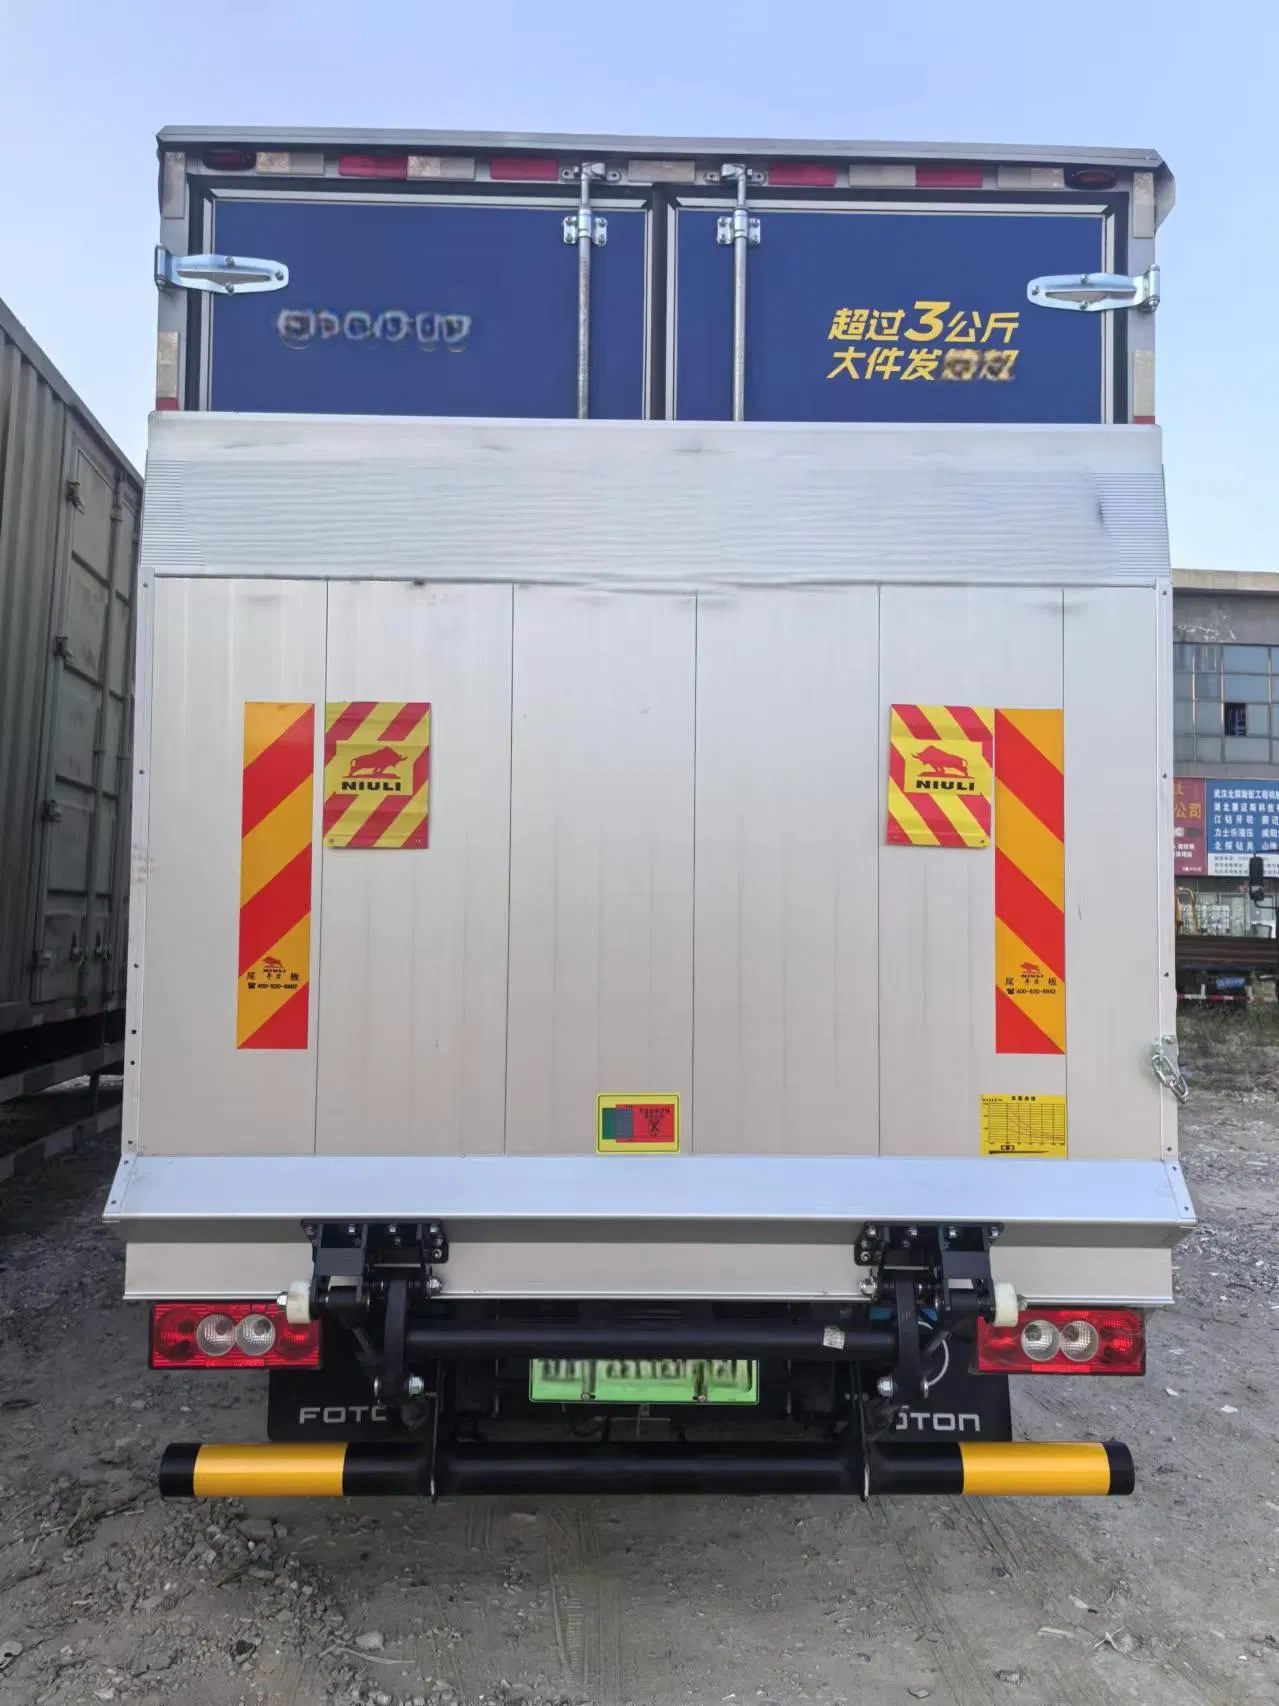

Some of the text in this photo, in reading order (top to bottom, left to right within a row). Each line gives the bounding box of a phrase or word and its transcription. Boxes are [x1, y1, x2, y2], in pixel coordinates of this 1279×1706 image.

[827, 300, 1021, 344] 超过3公斤
[826, 345, 1019, 382] 大件发
[341, 781, 402, 792] NIULI
[916, 780, 976, 791] NIULI
[299, 1405, 388, 1424] FOTO
[896, 1411, 981, 1432] OTON
